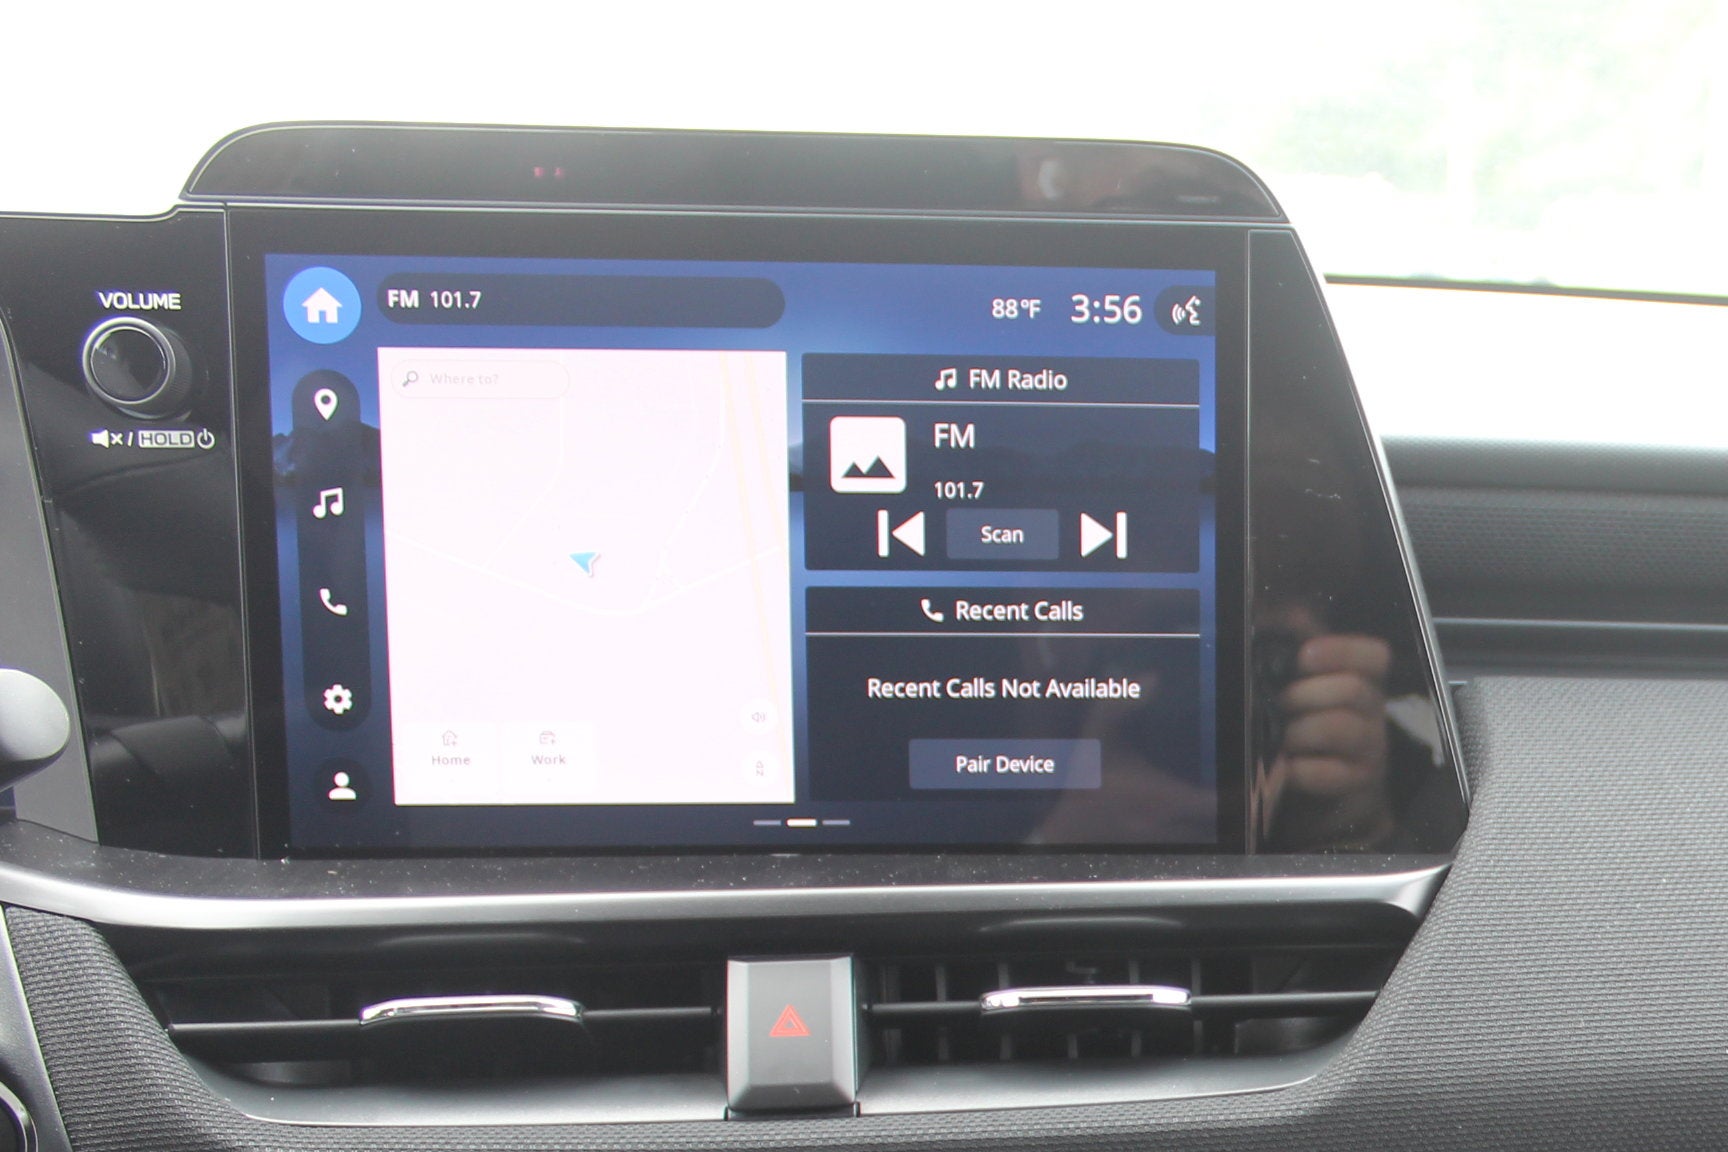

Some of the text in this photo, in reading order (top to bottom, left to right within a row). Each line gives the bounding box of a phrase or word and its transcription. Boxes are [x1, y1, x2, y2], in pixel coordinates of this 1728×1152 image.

[97, 291, 182, 310] VOLUME
[387, 290, 482, 309] FM 101.7
[1070, 294, 1143, 324] 3:56
[430, 373, 499, 385] Where to?
[968, 368, 1068, 389] FM Radio
[140, 432, 193, 446] HOLD
[933, 423, 975, 449] FM
[933, 481, 984, 499] 101.7
[980, 525, 1024, 545] Scan
[955, 600, 1083, 621] Recent Calls
[866, 677, 1140, 698] Recent Calls Not Available
[431, 755, 470, 766] Home
[531, 755, 566, 766] Work
[955, 755, 1054, 774] Pair Device
